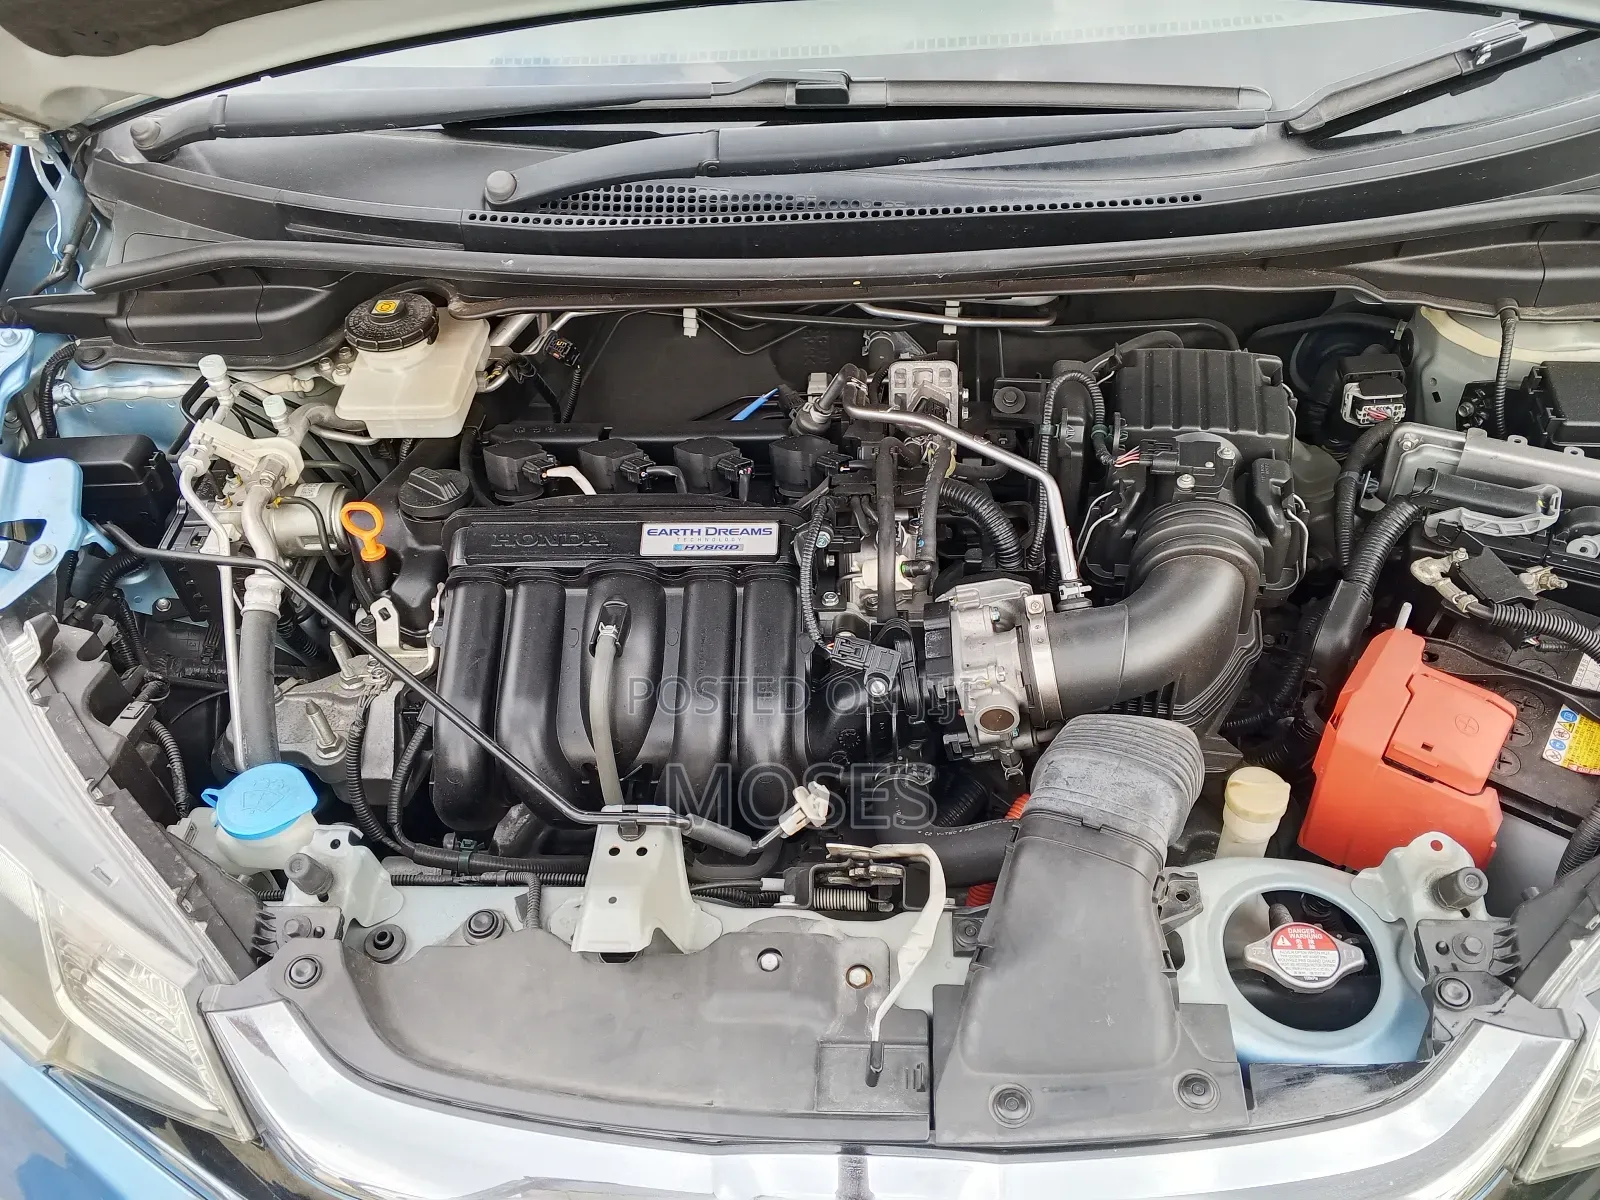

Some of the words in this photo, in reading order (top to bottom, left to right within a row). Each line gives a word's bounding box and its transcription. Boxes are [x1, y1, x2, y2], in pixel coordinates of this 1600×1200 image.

[646, 528, 700, 537] EARTH
[705, 526, 773, 537] DREAMS
[490, 533, 609, 547] HONDA
[1287, 927, 1316, 935] DANGER
